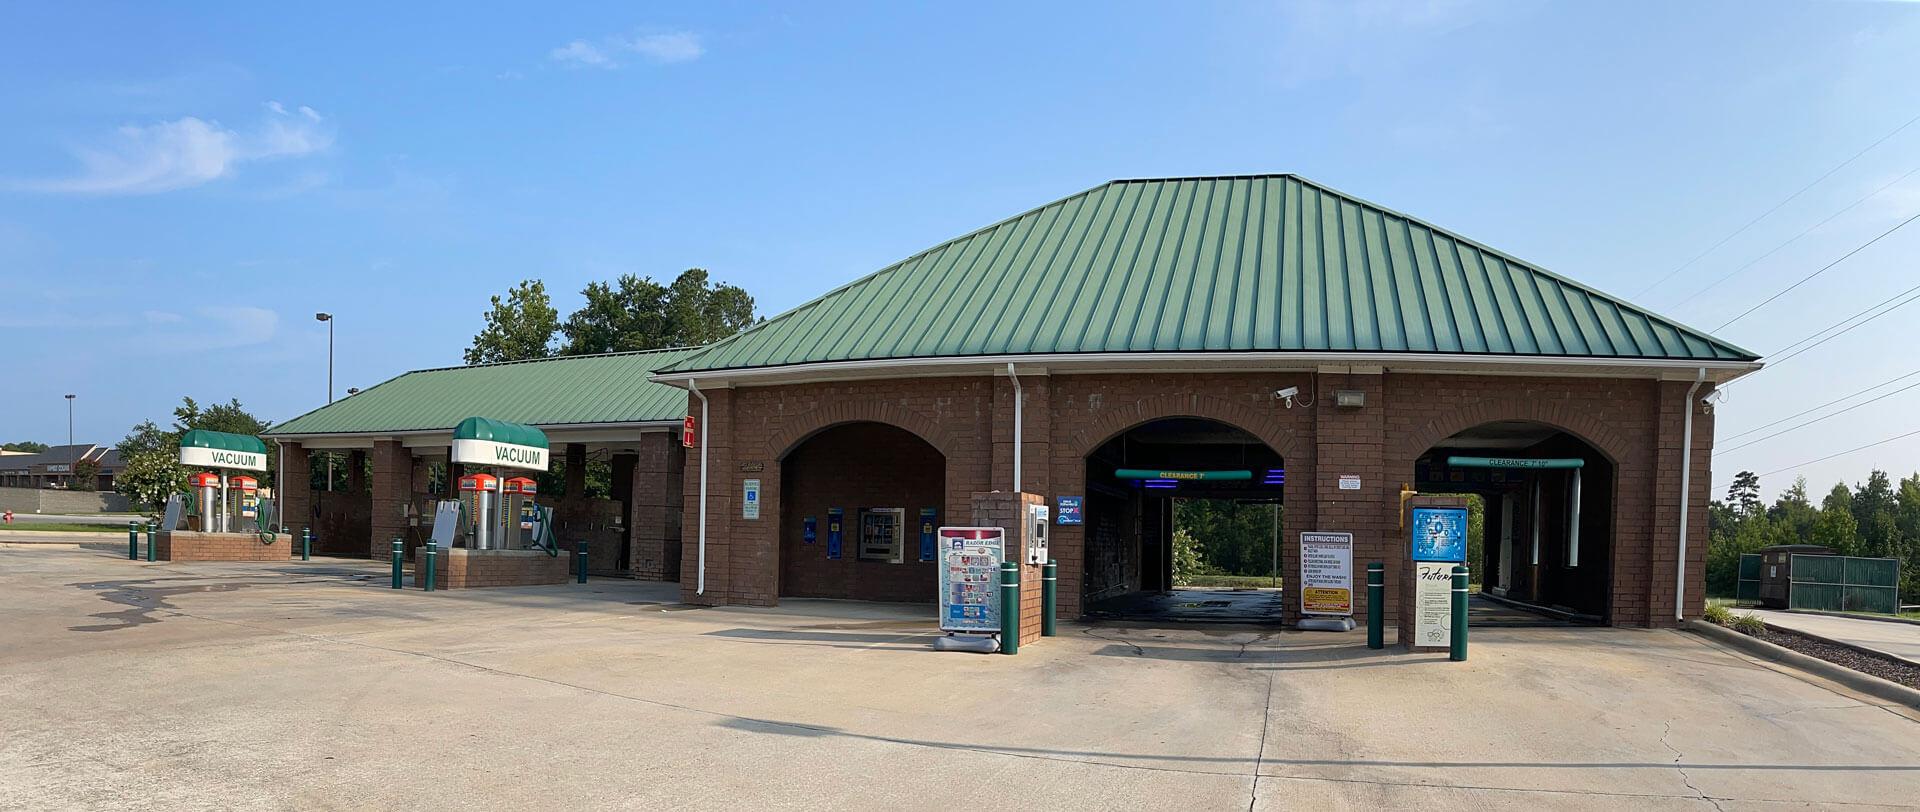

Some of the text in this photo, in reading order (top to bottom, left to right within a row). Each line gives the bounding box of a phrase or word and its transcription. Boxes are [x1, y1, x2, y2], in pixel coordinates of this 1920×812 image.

[212, 451, 256, 466] VACUUM
[496, 446, 540, 464] VACUUM
[1489, 458, 1529, 467] CLEARANCE
[1159, 471, 1198, 479] CLEARANCE
[1304, 535, 1349, 543] INSTRUCTIONS
